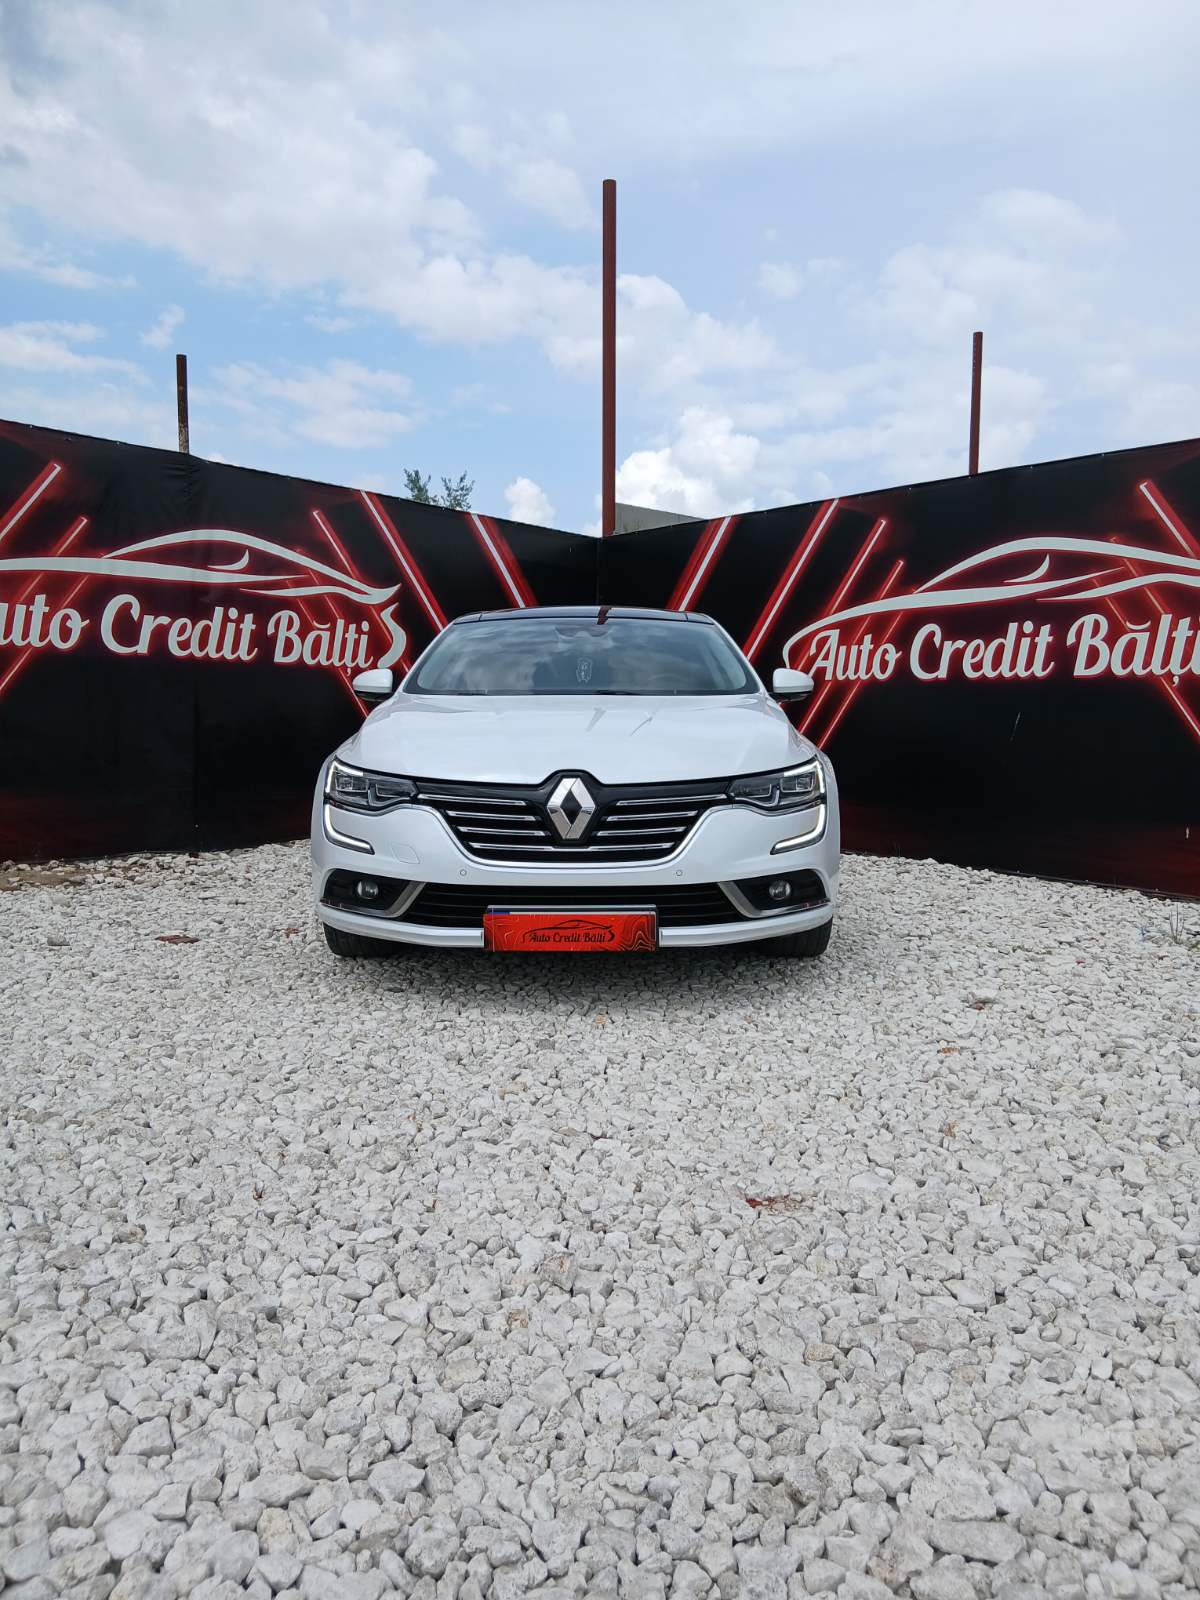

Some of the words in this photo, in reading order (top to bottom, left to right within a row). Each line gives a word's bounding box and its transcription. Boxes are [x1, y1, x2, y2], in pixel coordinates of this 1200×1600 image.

[0, 594, 90, 649] uto
[101, 594, 258, 661] Credit
[267, 610, 374, 676] Bălți
[808, 629, 902, 680] Auto
[910, 620, 1054, 679] Credit
[530, 932, 551, 942] Auto
[553, 931, 580, 942] Credit
